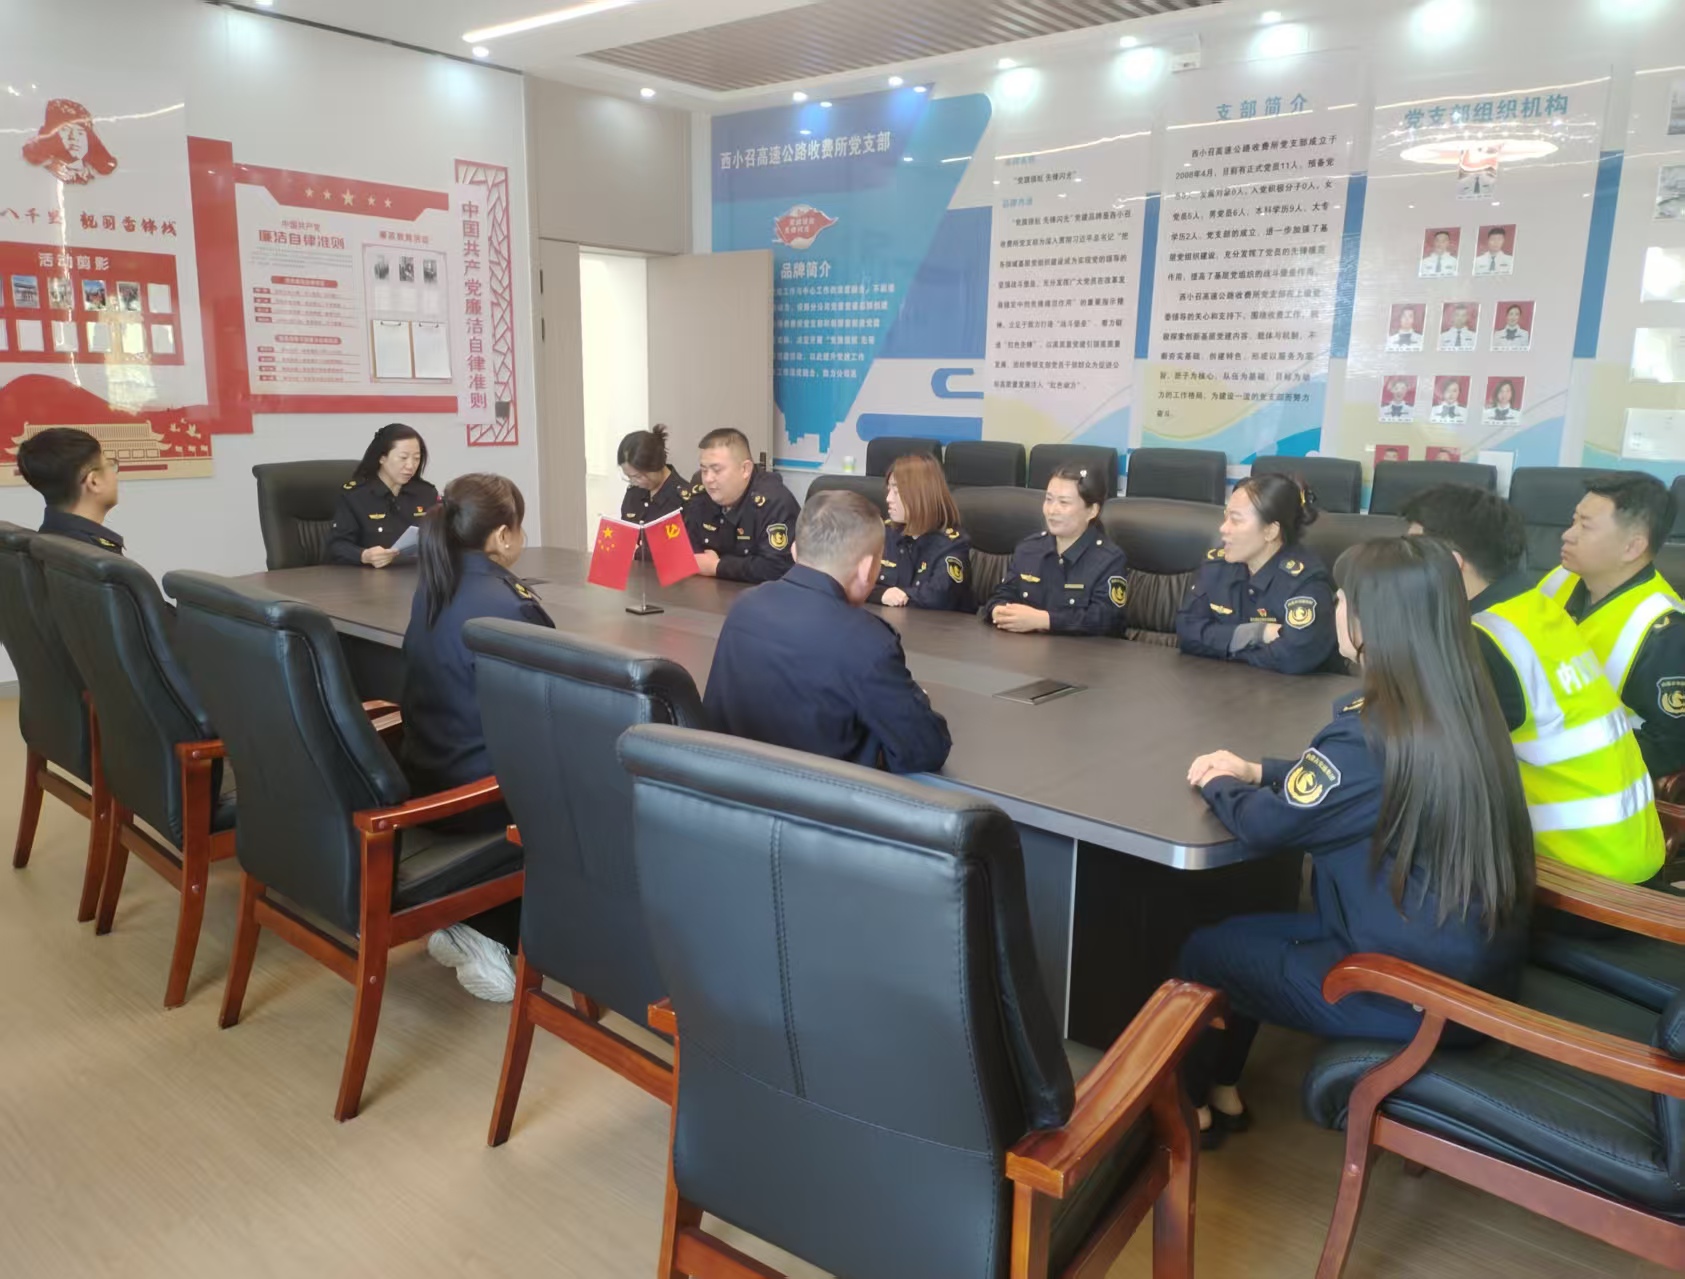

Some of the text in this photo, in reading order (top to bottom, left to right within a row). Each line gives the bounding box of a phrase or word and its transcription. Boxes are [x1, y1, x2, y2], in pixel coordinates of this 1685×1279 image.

[1215, 93, 1309, 121] 支部简介
[1404, 93, 1569, 129] 党支部组织机构
[719, 131, 891, 169] 西小召高速公路收费所党支部
[1191, 135, 1337, 158] 西小召高速公路收费所党支部成立于
[258, 229, 345, 250] 廉洁自律准则
[38, 252, 110, 271] 活动剪影
[780, 260, 831, 279] 品牌简介
[461, 200, 487, 409] 中国共产党廉洁自律准则
